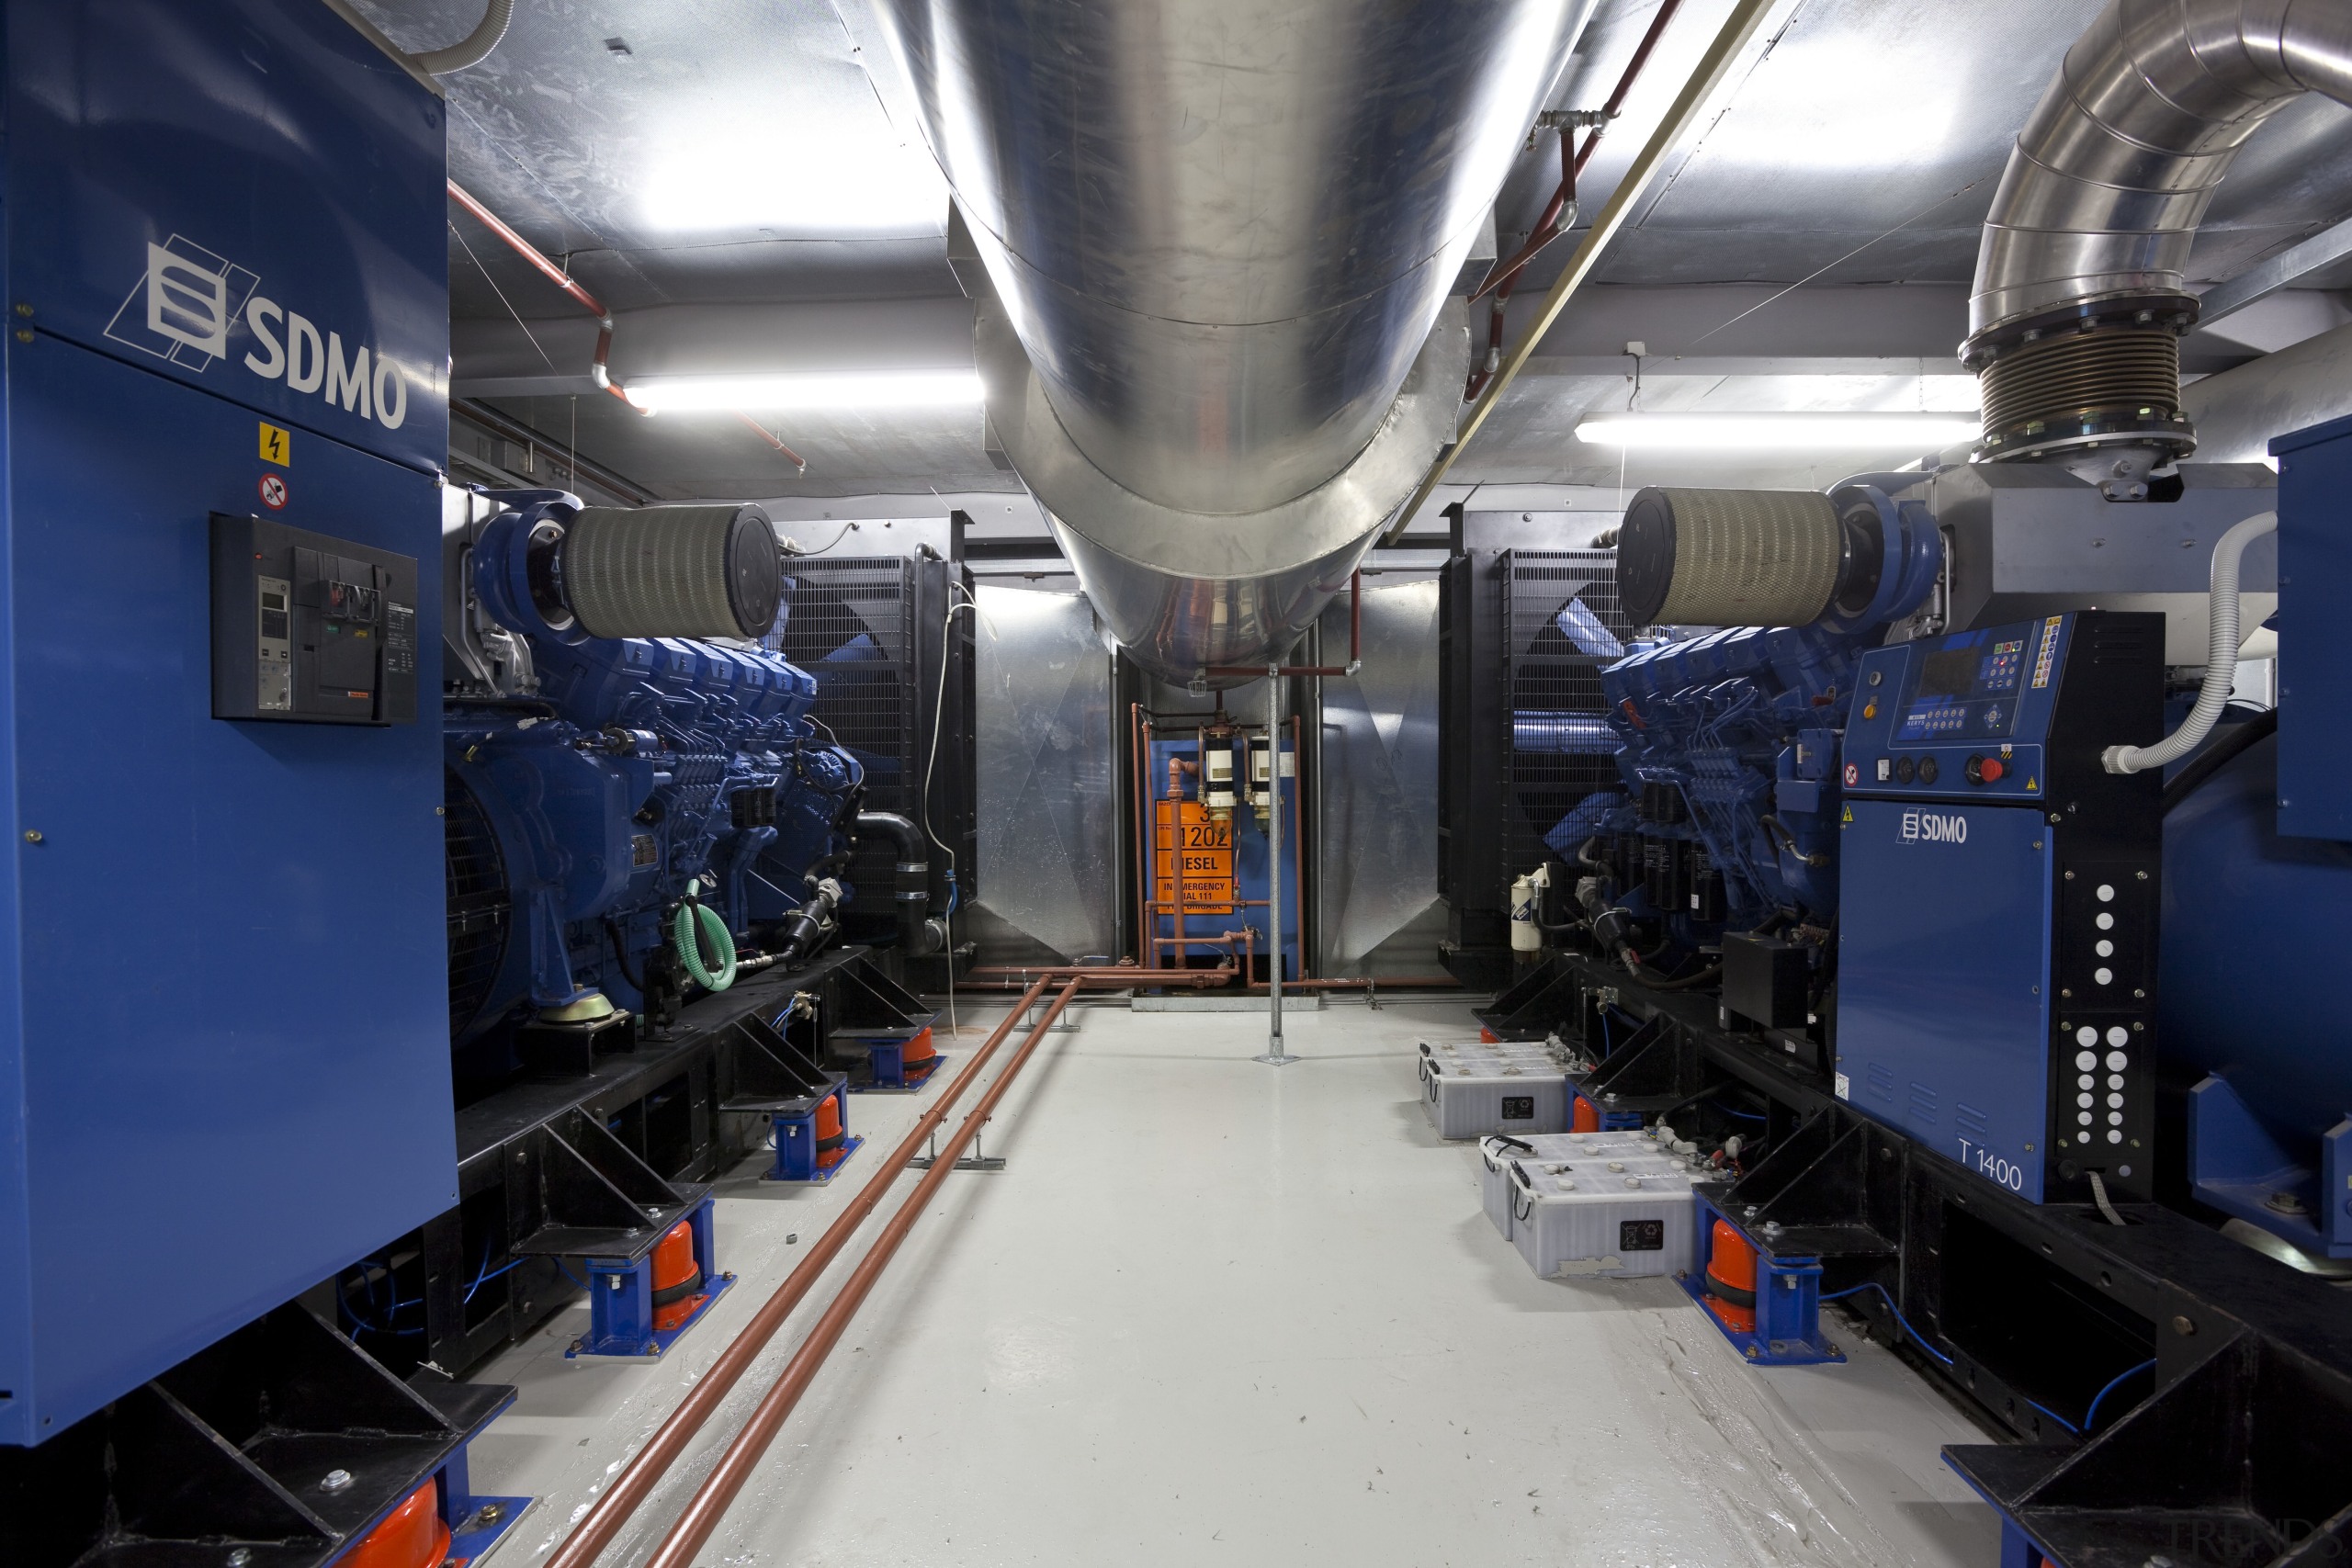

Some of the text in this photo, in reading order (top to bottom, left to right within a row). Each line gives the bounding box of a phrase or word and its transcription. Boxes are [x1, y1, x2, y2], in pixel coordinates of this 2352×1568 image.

[243, 296, 407, 430] SDMO
[1922, 814, 1967, 844] SDMO
[1171, 857, 1218, 870] IESEL
[1164, 883, 1225, 891] IN MERGENCY
[1183, 892, 1212, 900] IAL 111
[1959, 1138, 2022, 1190] T 1400
